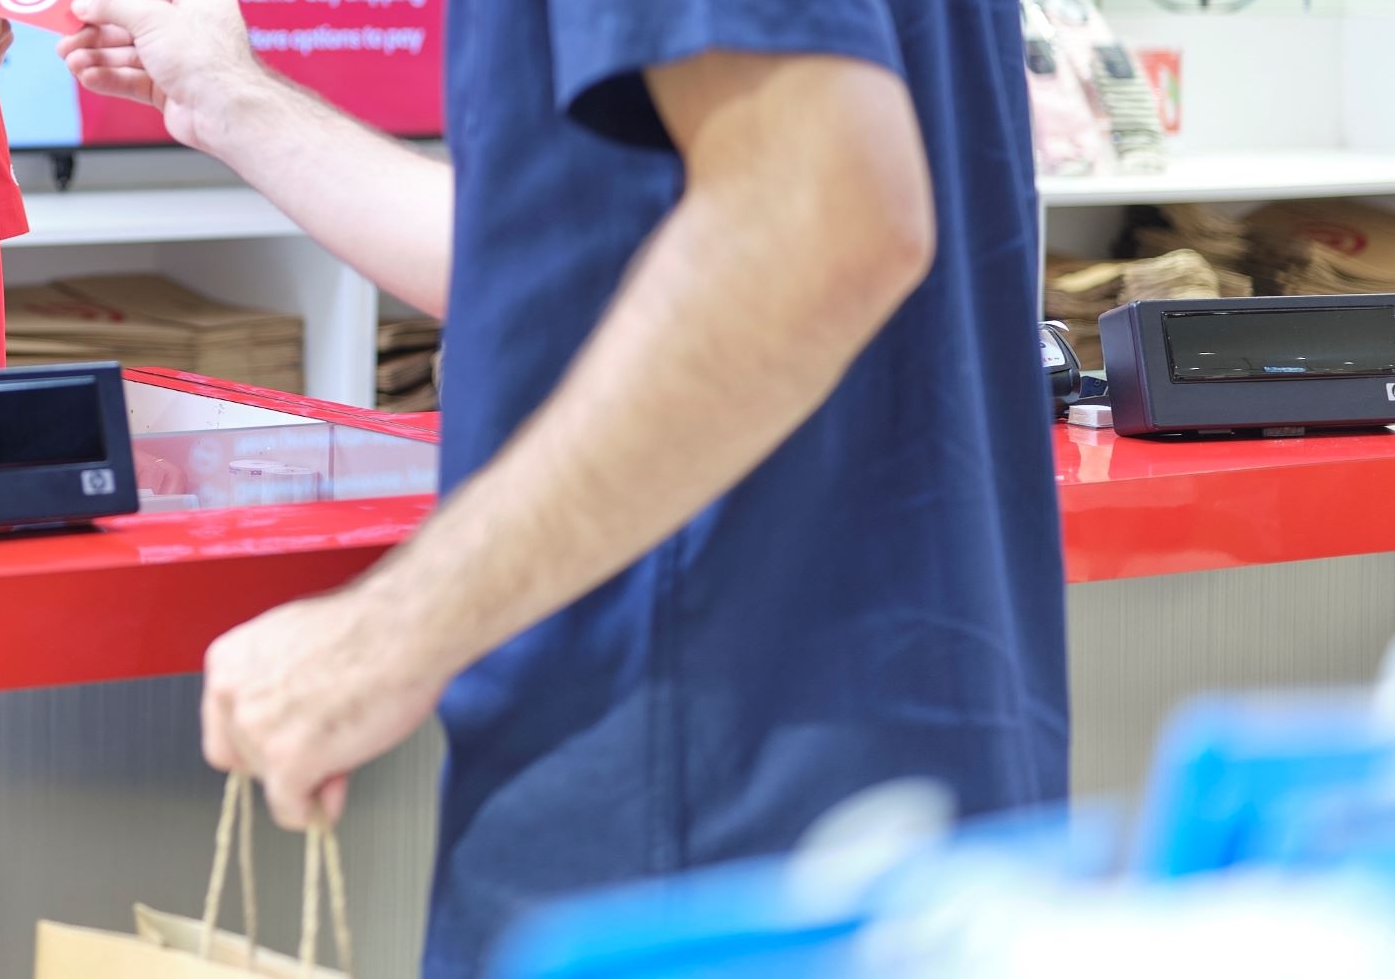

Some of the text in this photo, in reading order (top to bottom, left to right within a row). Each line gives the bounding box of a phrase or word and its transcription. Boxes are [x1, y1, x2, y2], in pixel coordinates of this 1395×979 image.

[249, 24, 426, 56] ore options to pay
